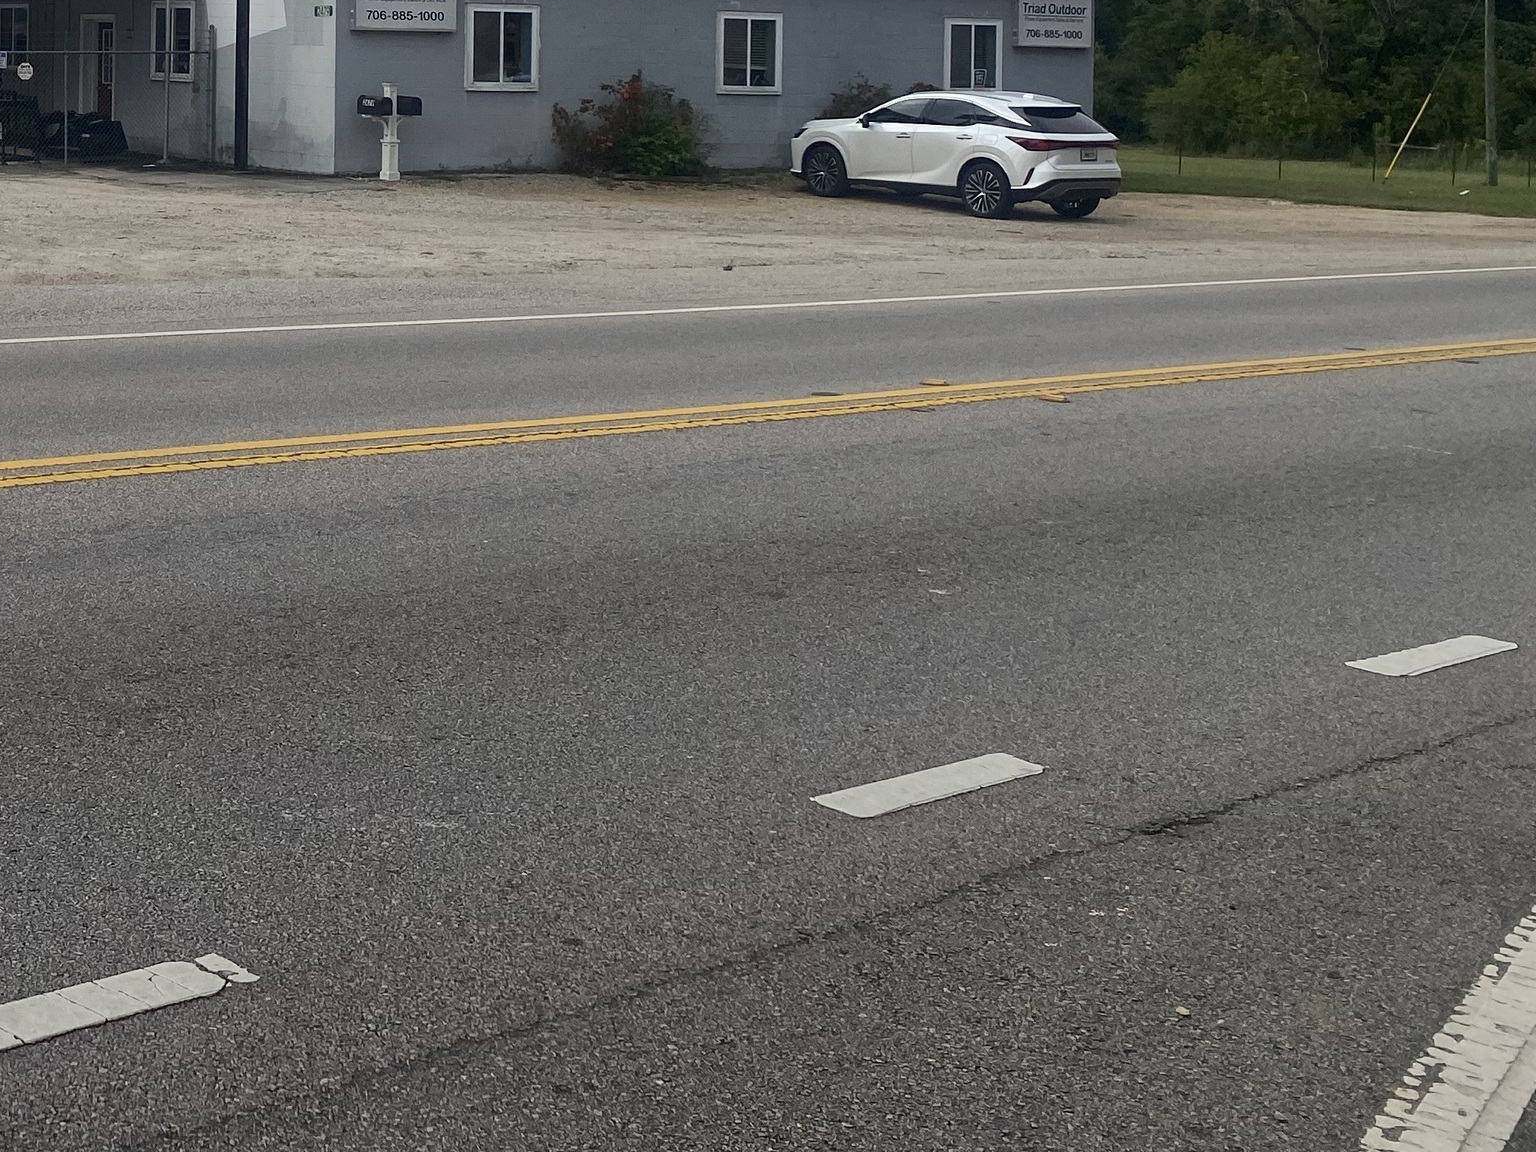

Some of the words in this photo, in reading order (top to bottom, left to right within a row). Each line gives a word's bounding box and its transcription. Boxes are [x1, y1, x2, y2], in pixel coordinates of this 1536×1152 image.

[1023, 2, 1046, 14] Triad
[1048, 4, 1087, 16] Outdoor
[366, 10, 445, 21] 706-885-1000
[1026, 29, 1083, 39] 706-885-1000
